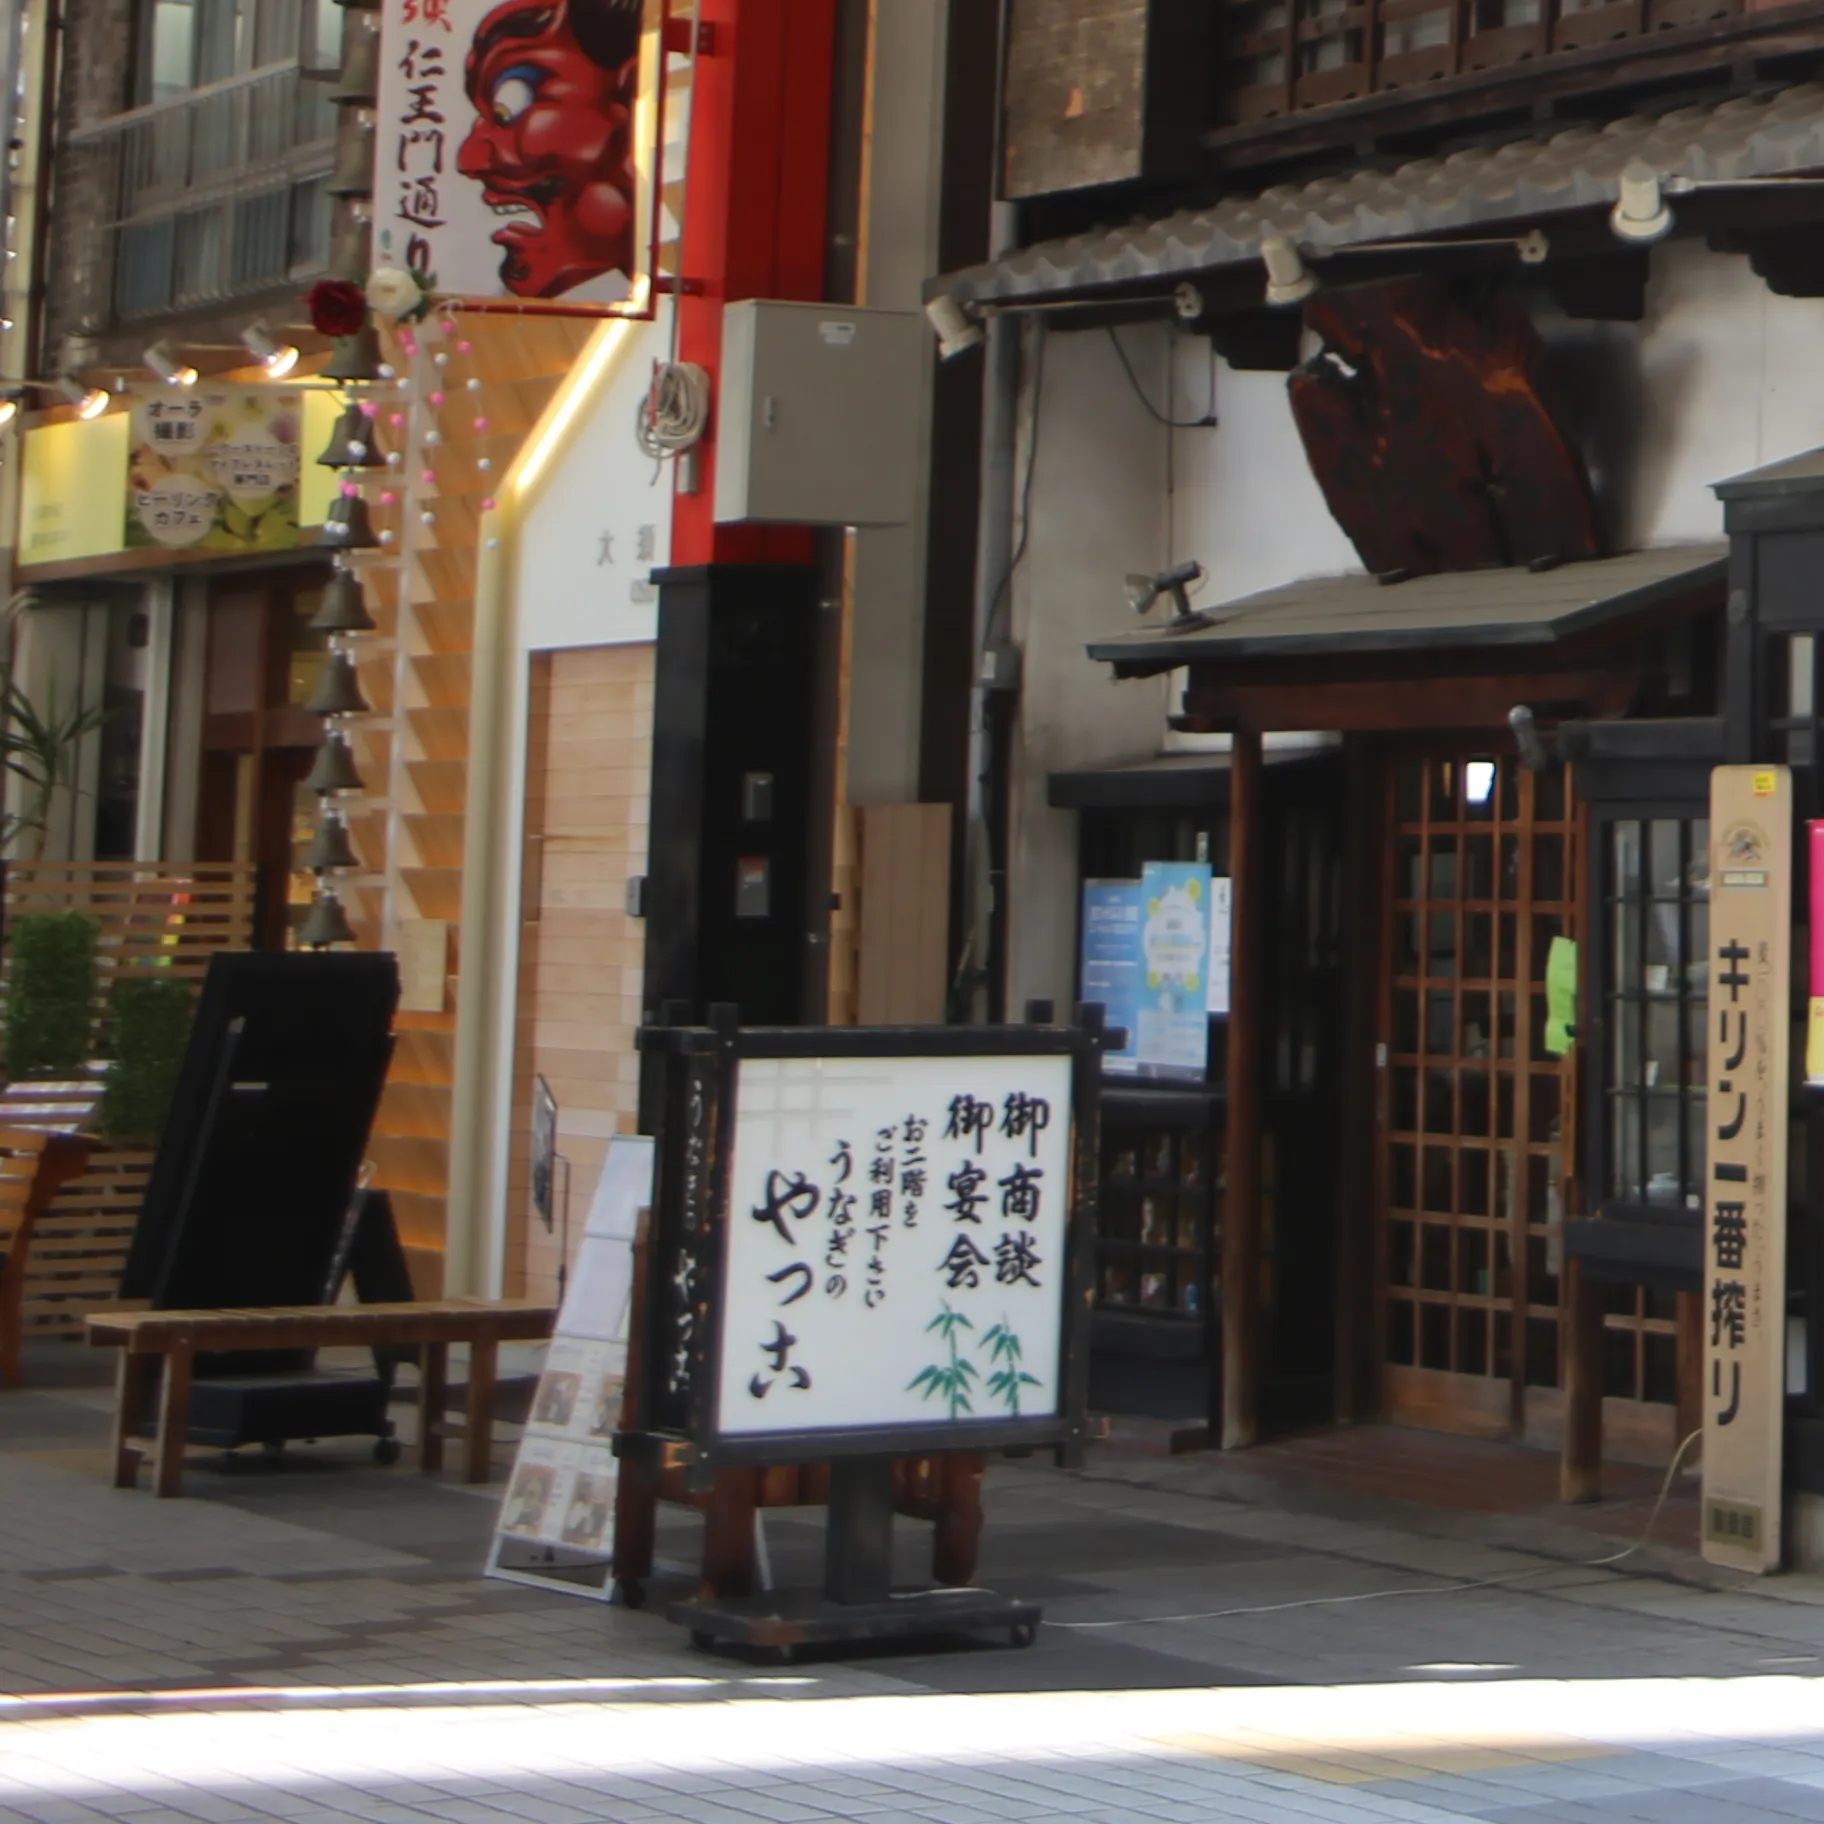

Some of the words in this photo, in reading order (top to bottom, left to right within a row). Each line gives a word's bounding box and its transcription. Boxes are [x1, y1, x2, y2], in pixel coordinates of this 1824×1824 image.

[147, 399, 203, 418] オーラ
[155, 510, 203, 526] カフェ
[825, 1139, 856, 1299] うなぎの
[864, 1125, 898, 1309] ご利用下さい
[900, 1113, 929, 1228] お二階を
[937, 1093, 995, 1288] 御宴会
[993, 1092, 1050, 1288] 御商談
[1711, 939, 1750, 1425] キリン一番搾り
